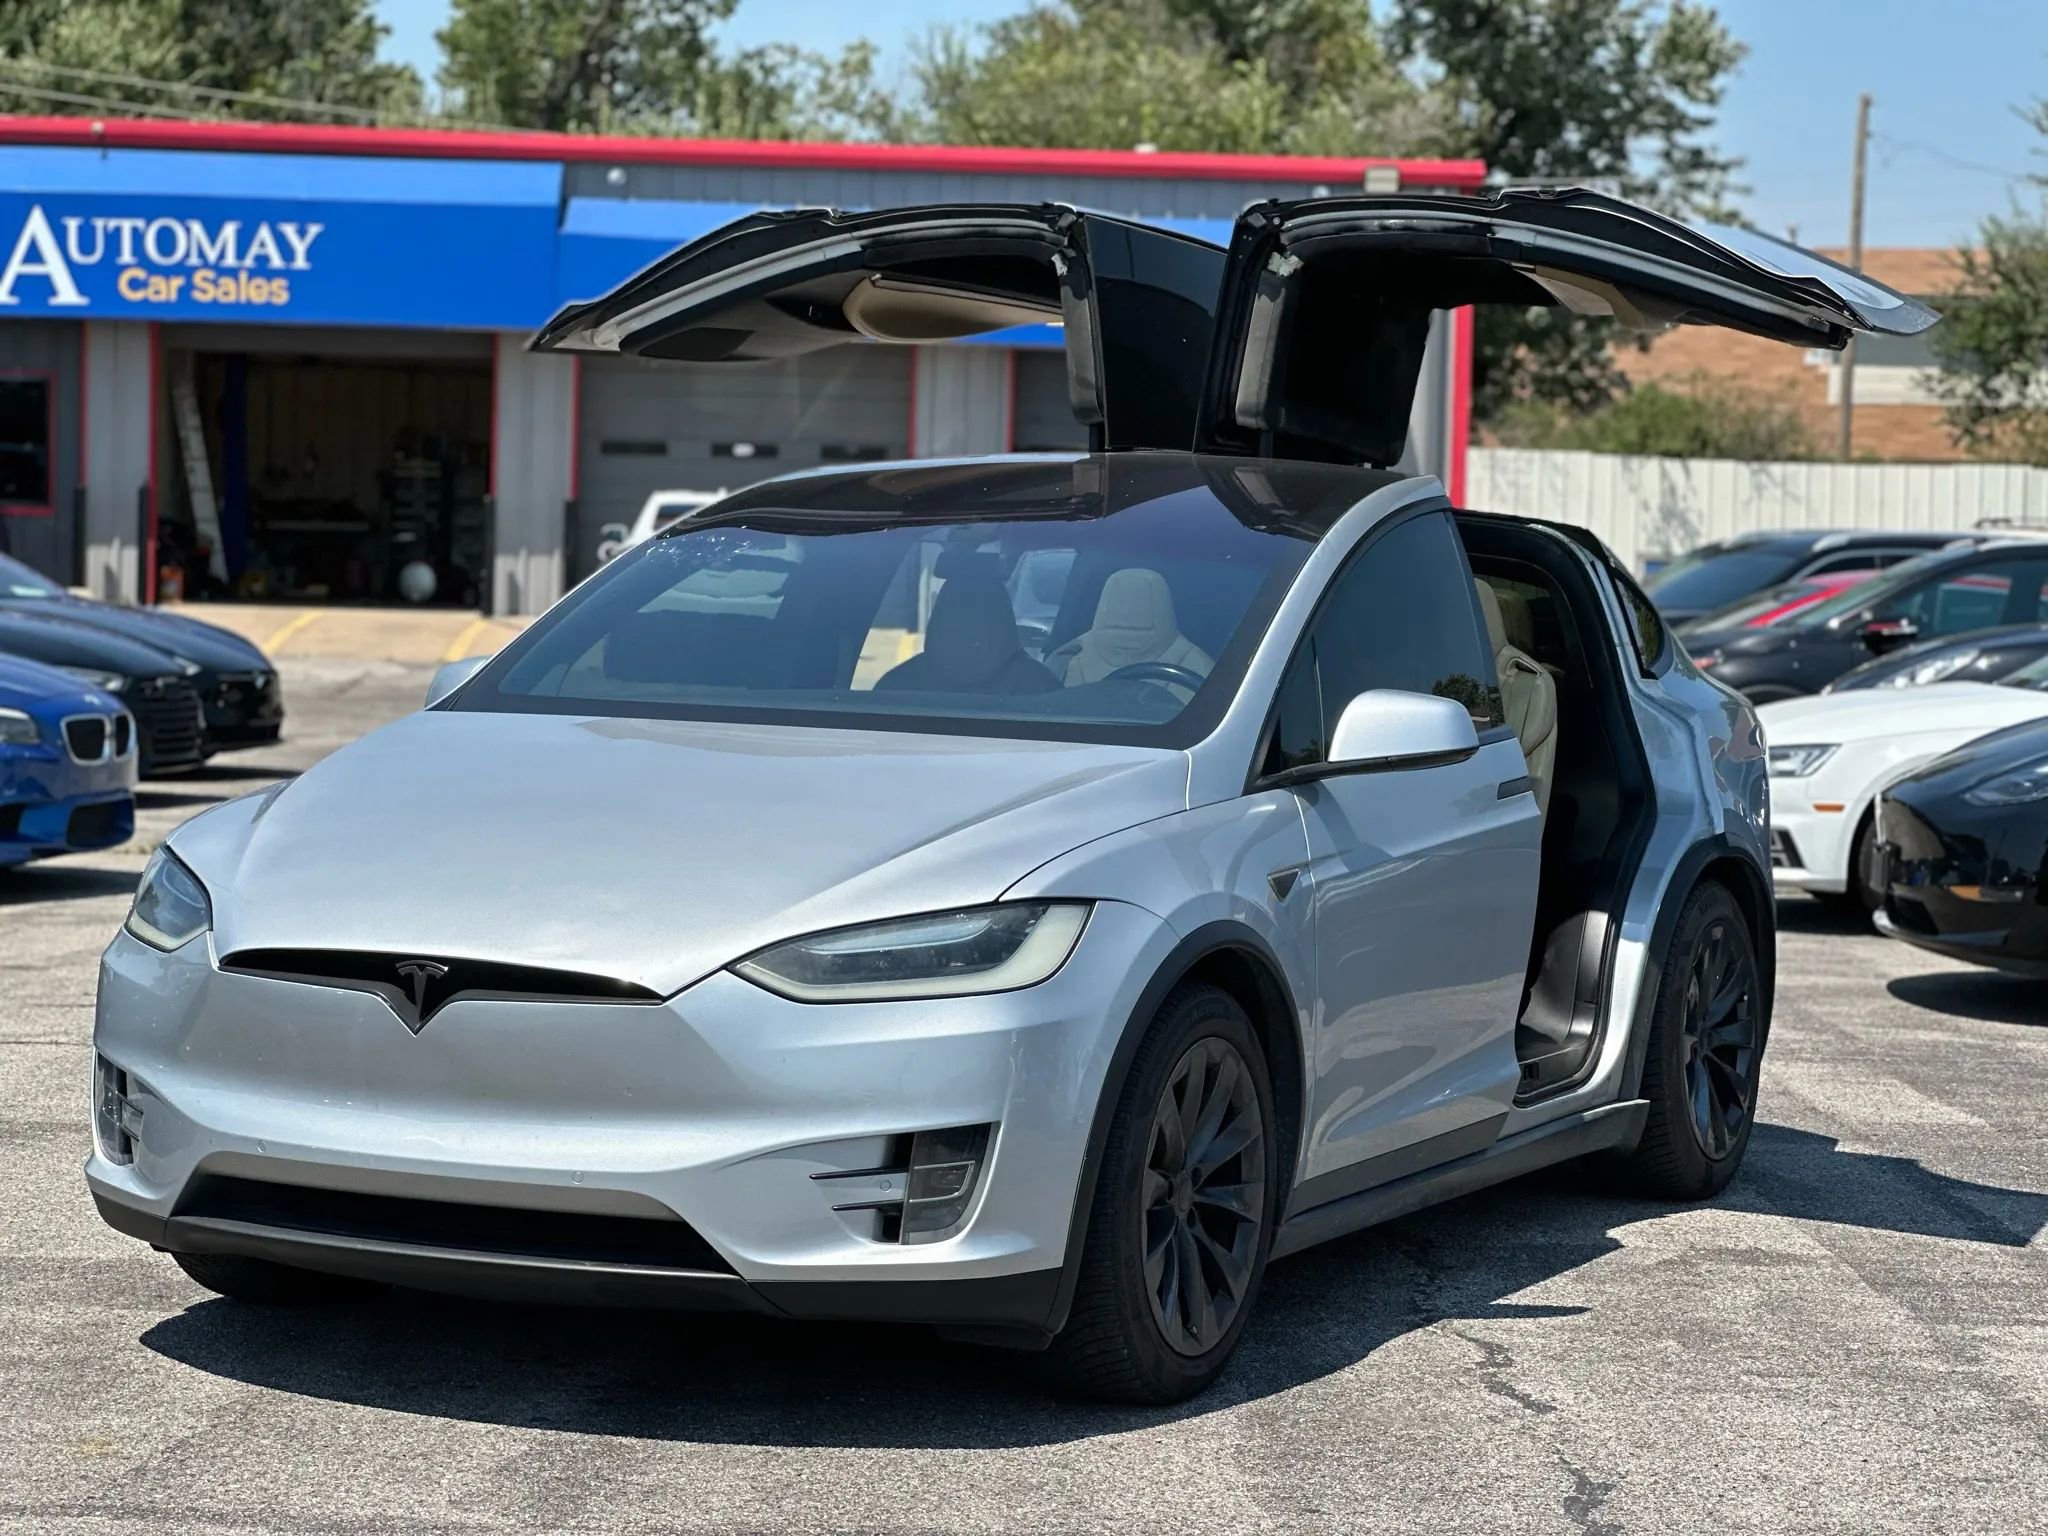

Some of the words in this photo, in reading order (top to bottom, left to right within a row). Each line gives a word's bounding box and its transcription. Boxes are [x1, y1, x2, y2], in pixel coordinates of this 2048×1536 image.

[0, 204, 324, 306] AUTOMAY
[117, 266, 185, 302] Car
[191, 268, 290, 306] Sales
